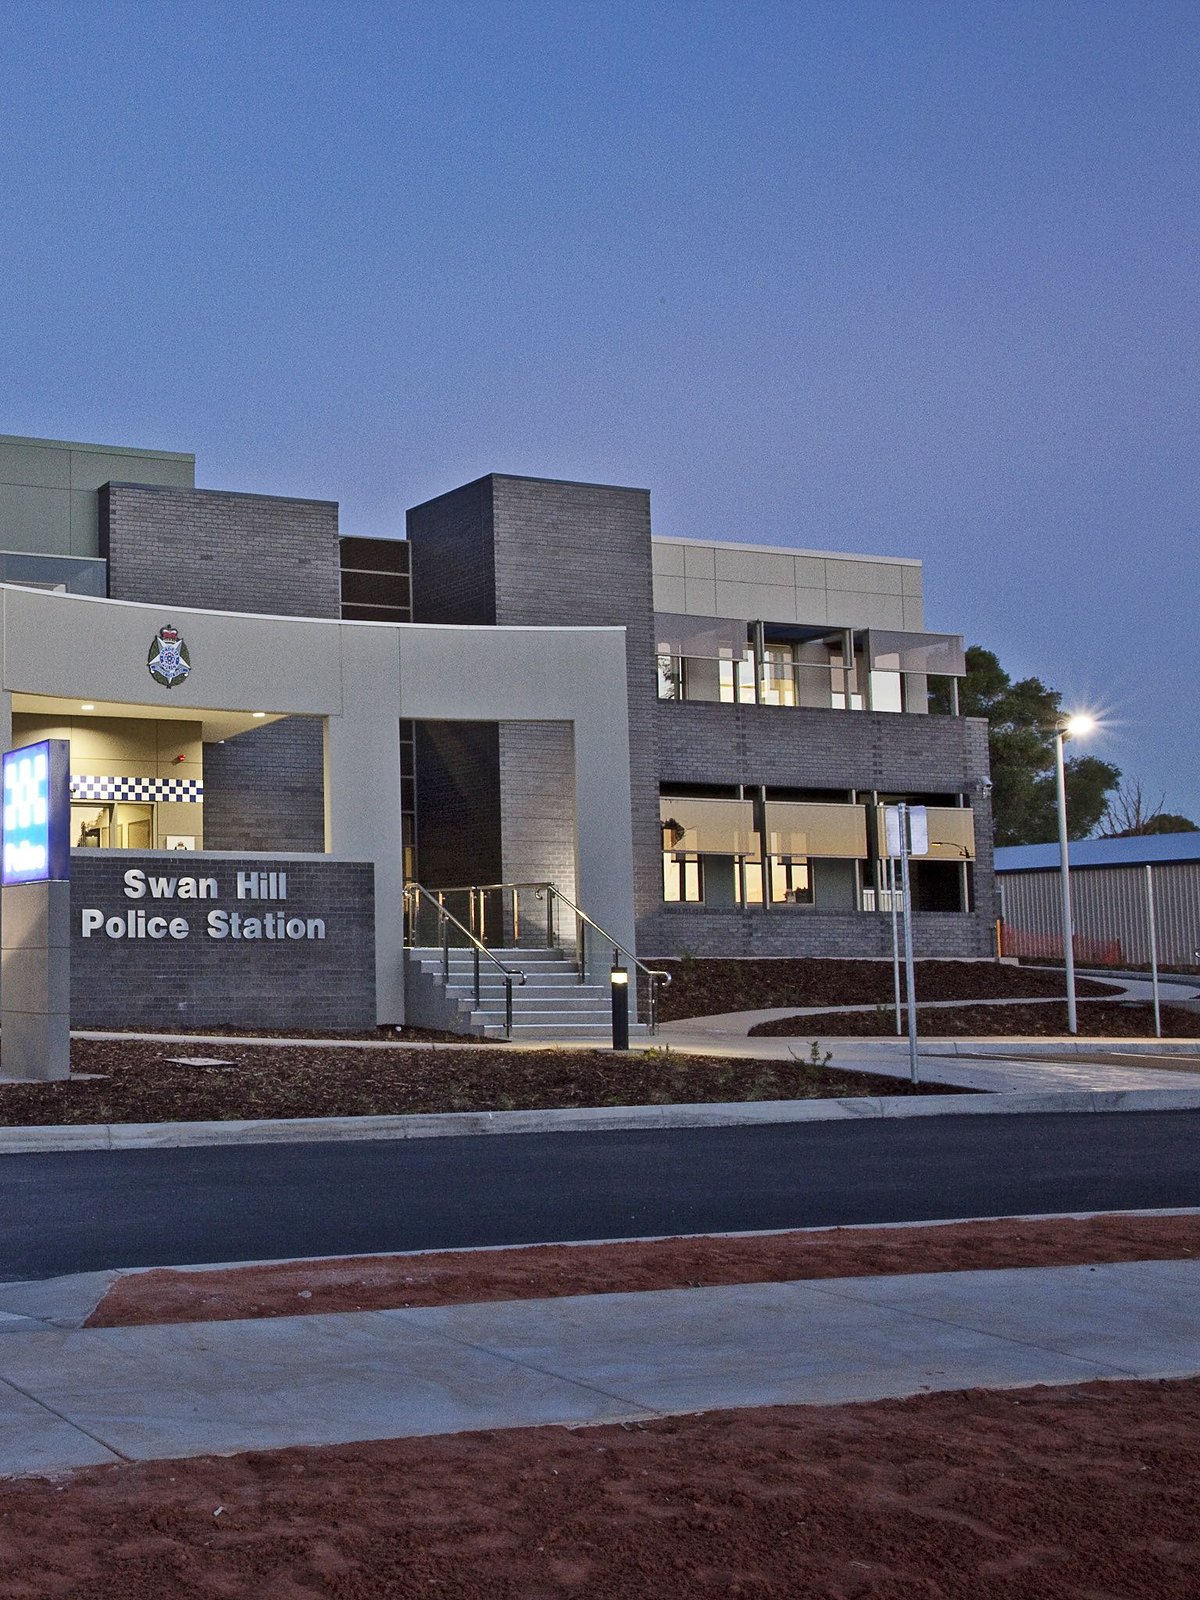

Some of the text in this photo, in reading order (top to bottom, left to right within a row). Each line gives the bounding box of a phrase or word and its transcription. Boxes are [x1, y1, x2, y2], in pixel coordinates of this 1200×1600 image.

[124, 869, 287, 899] Swan Hill
[82, 909, 326, 939] Police Station
